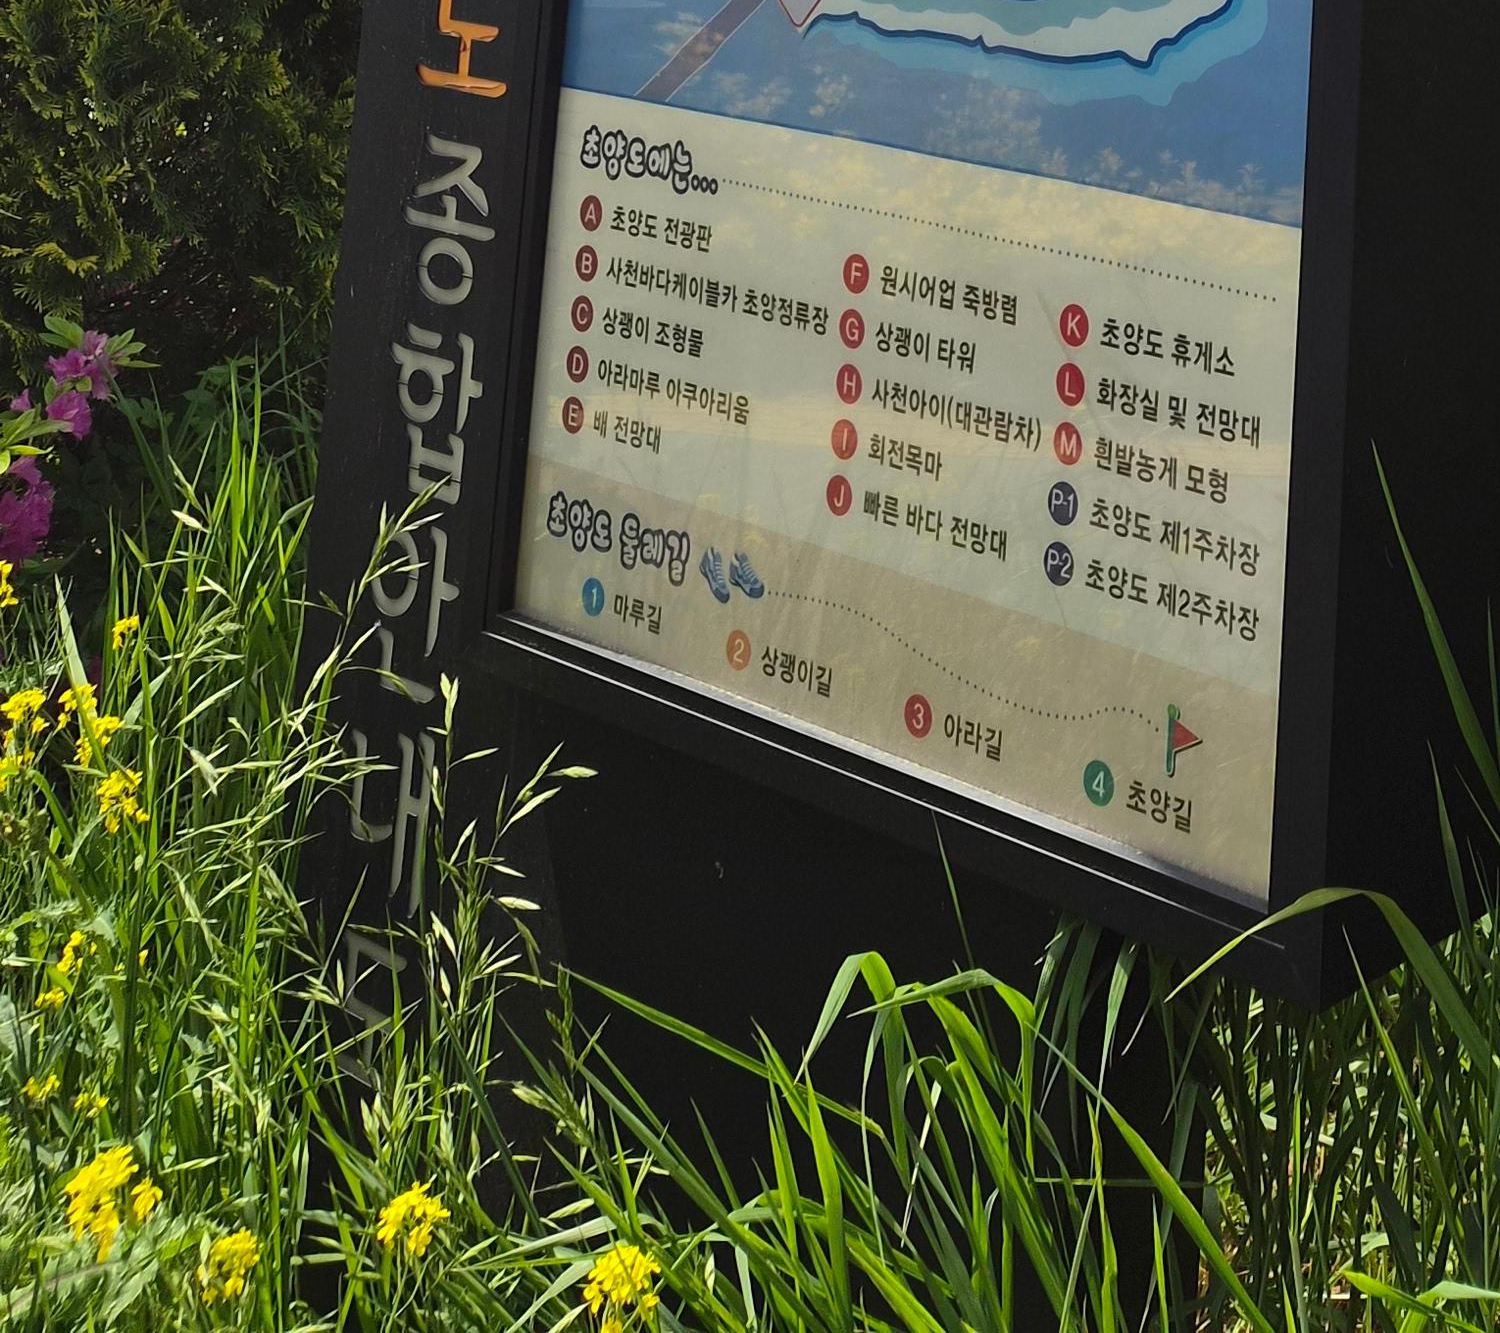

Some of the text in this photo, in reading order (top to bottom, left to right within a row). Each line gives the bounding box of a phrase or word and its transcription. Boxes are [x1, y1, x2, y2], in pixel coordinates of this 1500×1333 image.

[583, 202, 713, 253] A 초양도 전광판
[580, 252, 829, 336] B 사천바다케이블카 초양정류장
[850, 262, 1018, 326] F 원시어업 죽방렴
[577, 302, 704, 358] C 상괭이 조형물
[846, 317, 976, 374] G 상괭이 타워
[1066, 312, 1236, 377] K 초양도 휴게소
[571, 353, 750, 426] D 아라마루 아쿠아리움
[843, 372, 1042, 452] H 사천아이(대관람차)
[1064, 372, 1261, 449] L 화장실 및 전망대
[568, 405, 662, 455] E 배 전망대
[868, 433, 943, 482] 회전목마
[1060, 432, 1229, 504] M 흰발농게 모형
[547, 491, 690, 587] 초양도 둘레길
[834, 484, 1008, 562] J 빠른 바다 전망대
[1051, 488, 1260, 577] P-1 초양도 제1주차장
[613, 593, 662, 635] 마루길
[1047, 549, 1260, 642] P-2 초양도 제2주차장
[732, 637, 833, 698] 2 상괭이길
[911, 703, 1003, 762] 3 아라길
[1091, 771, 1193, 834] 4 초양길
